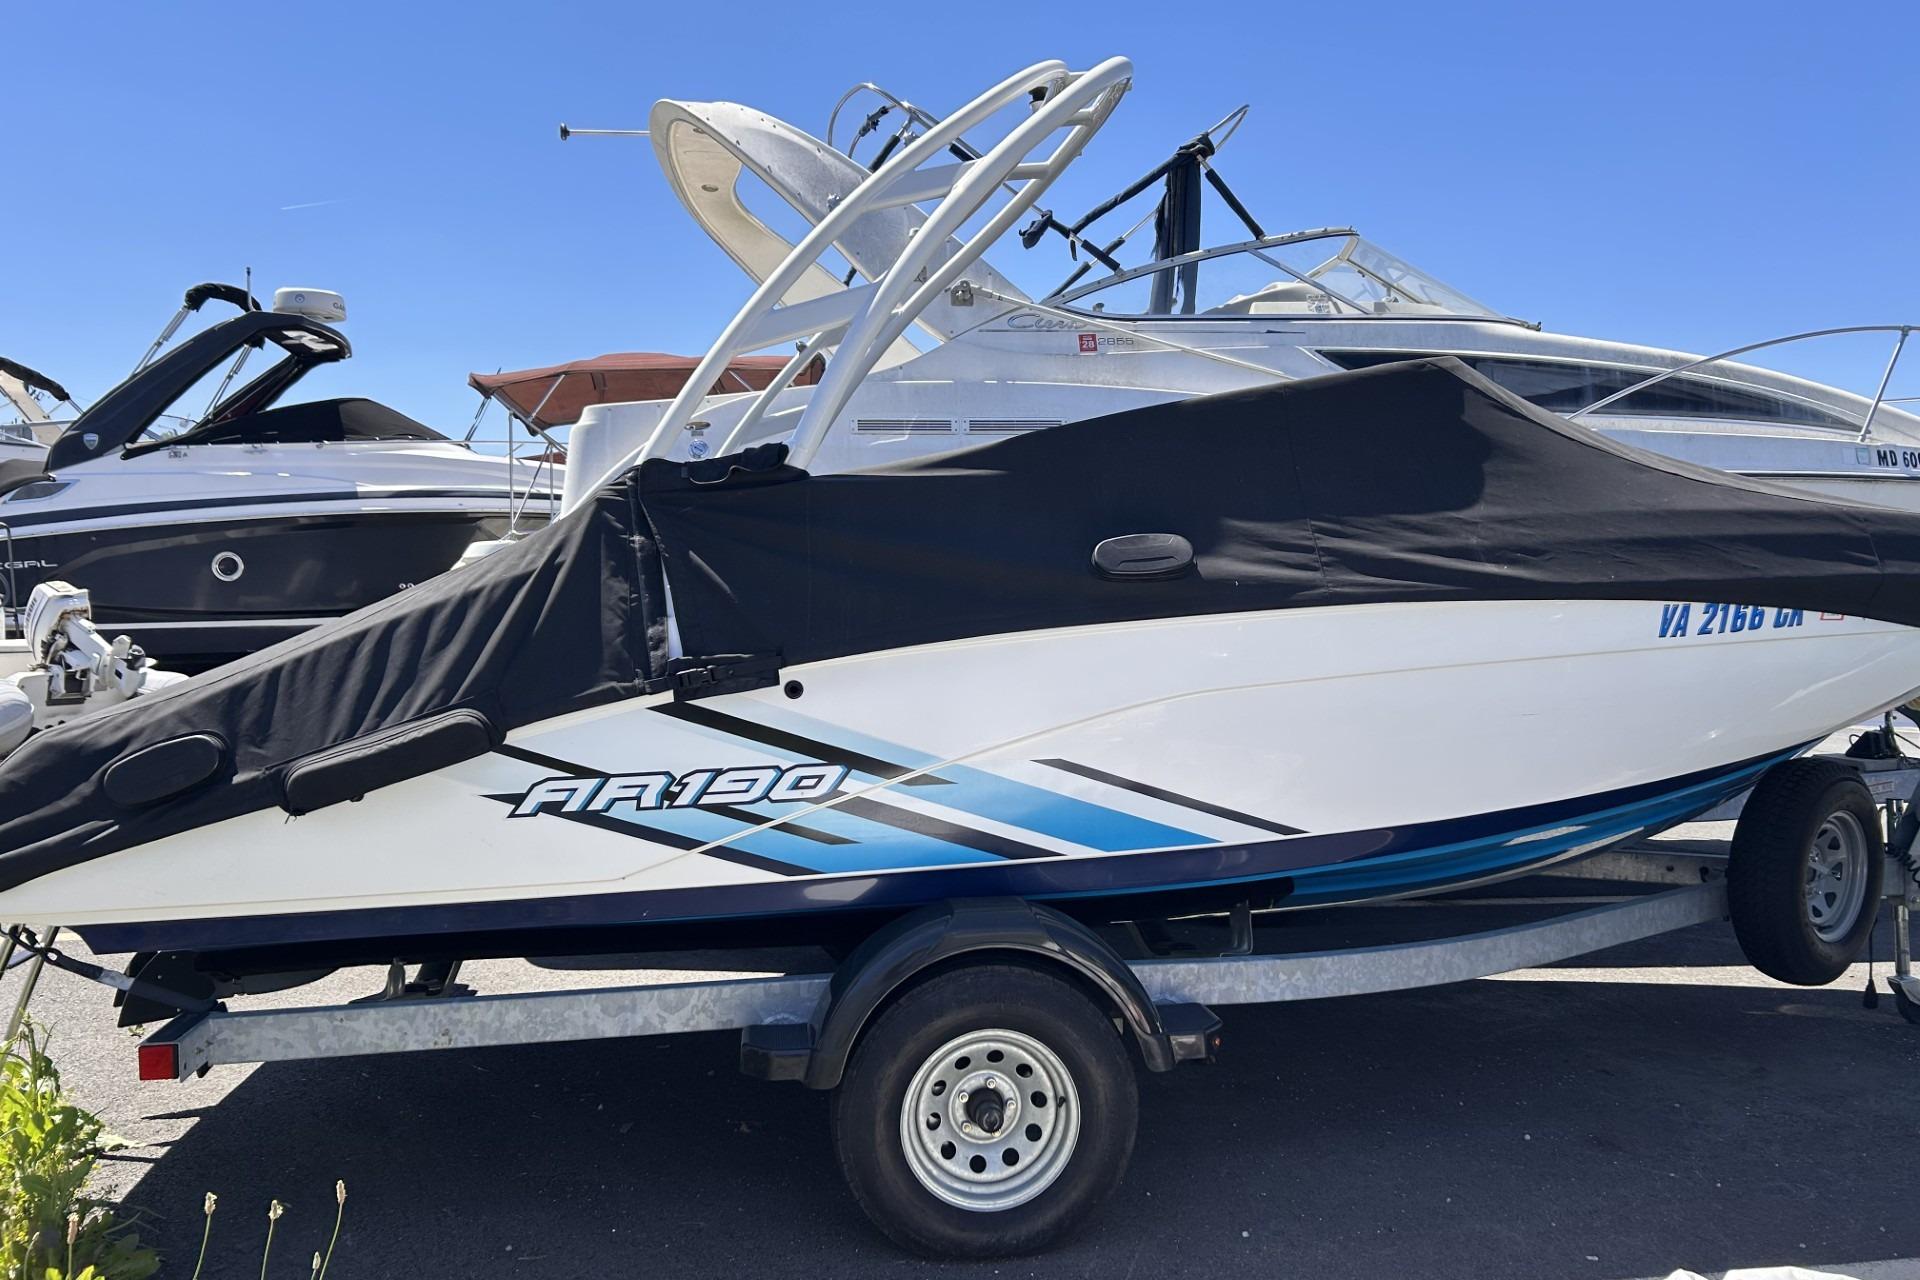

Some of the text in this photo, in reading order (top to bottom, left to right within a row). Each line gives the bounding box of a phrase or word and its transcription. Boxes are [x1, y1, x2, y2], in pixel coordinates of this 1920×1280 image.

[1097, 337, 1134, 346] 2855
[1876, 449, 1920, 469] MD 60
[1659, 602, 1691, 638] VA
[1697, 602, 1765, 636] 2166
